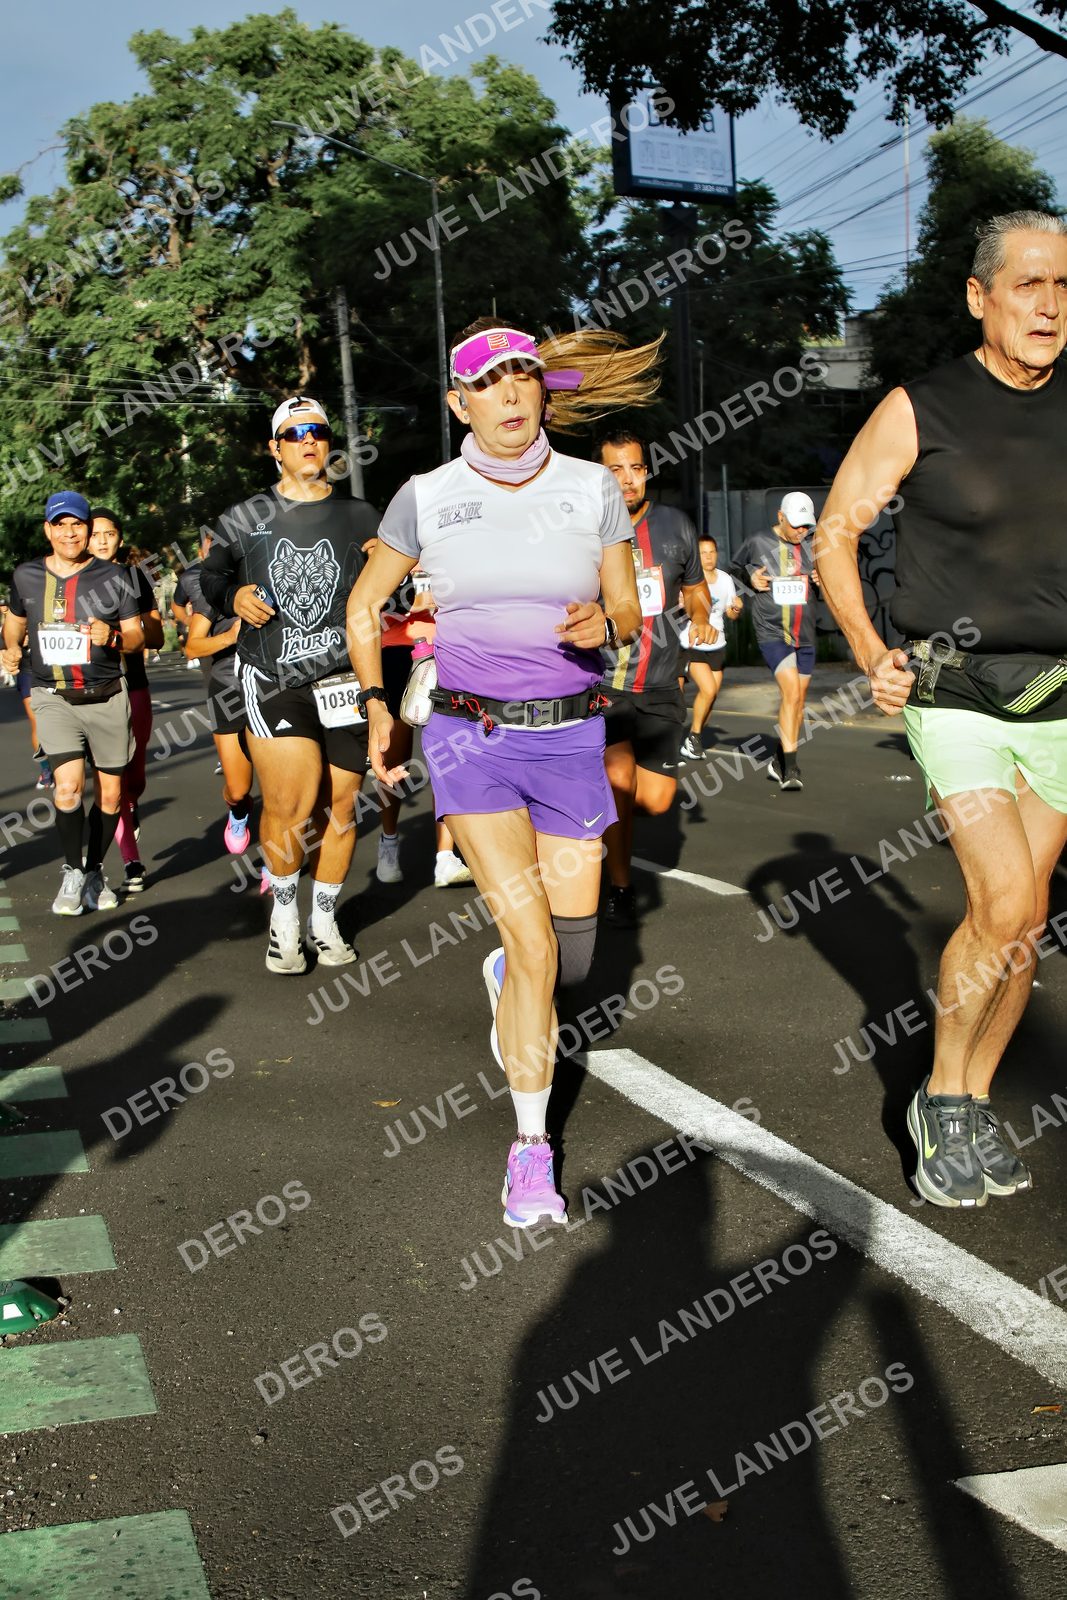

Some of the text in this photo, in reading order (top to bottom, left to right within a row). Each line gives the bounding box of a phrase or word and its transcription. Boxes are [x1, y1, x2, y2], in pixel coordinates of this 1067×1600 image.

[464, 506, 482, 518] 10K
[776, 585, 803, 594] 12339
[282, 627, 303, 641] LA
[42, 636, 83, 650] 10027
[320, 688, 360, 710] 1038
